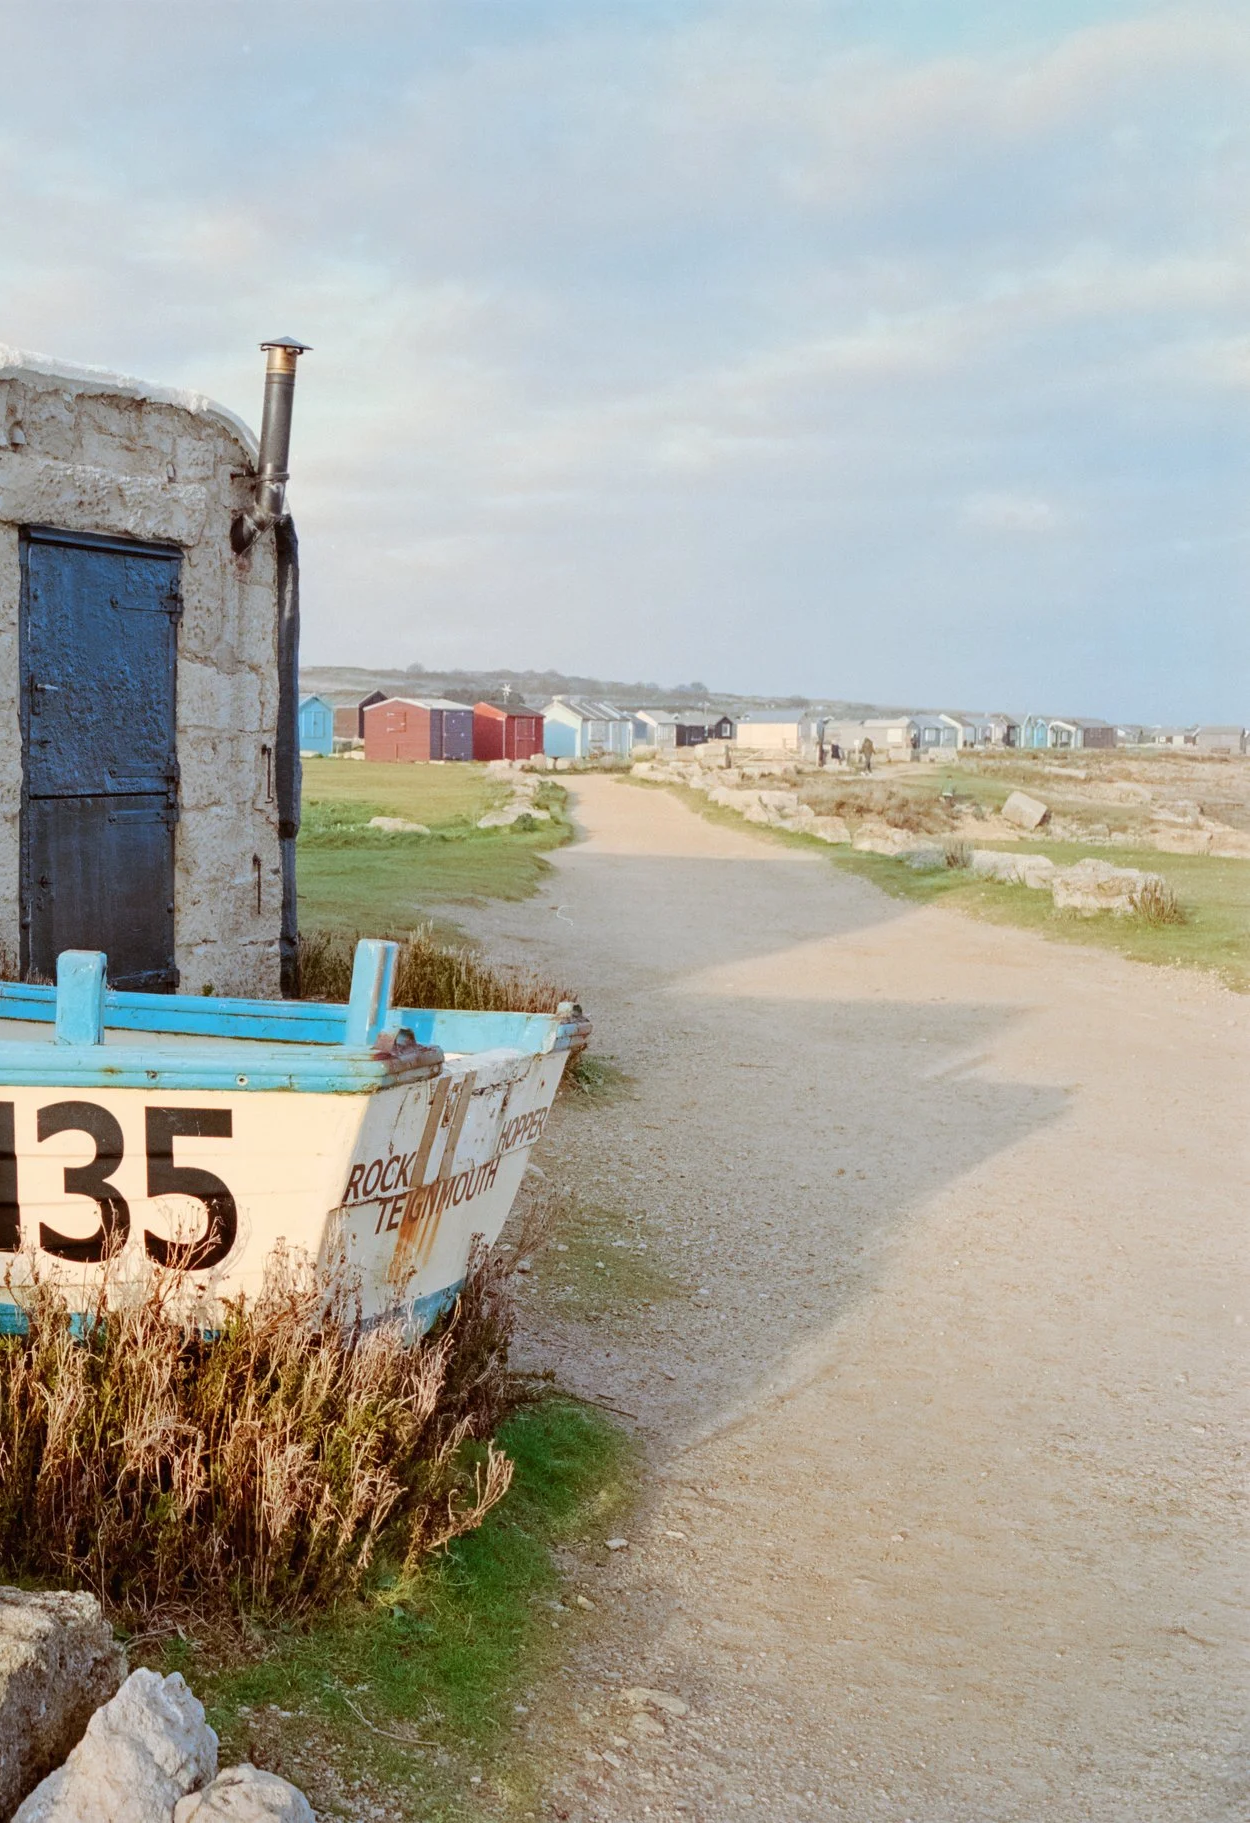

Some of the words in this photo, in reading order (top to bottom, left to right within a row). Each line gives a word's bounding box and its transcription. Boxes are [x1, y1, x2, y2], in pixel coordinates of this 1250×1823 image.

[344, 1151, 417, 1203] ROCK
[497, 1106, 549, 1153] HOPPER
[375, 1157, 501, 1235] TEIGNMOUTH
